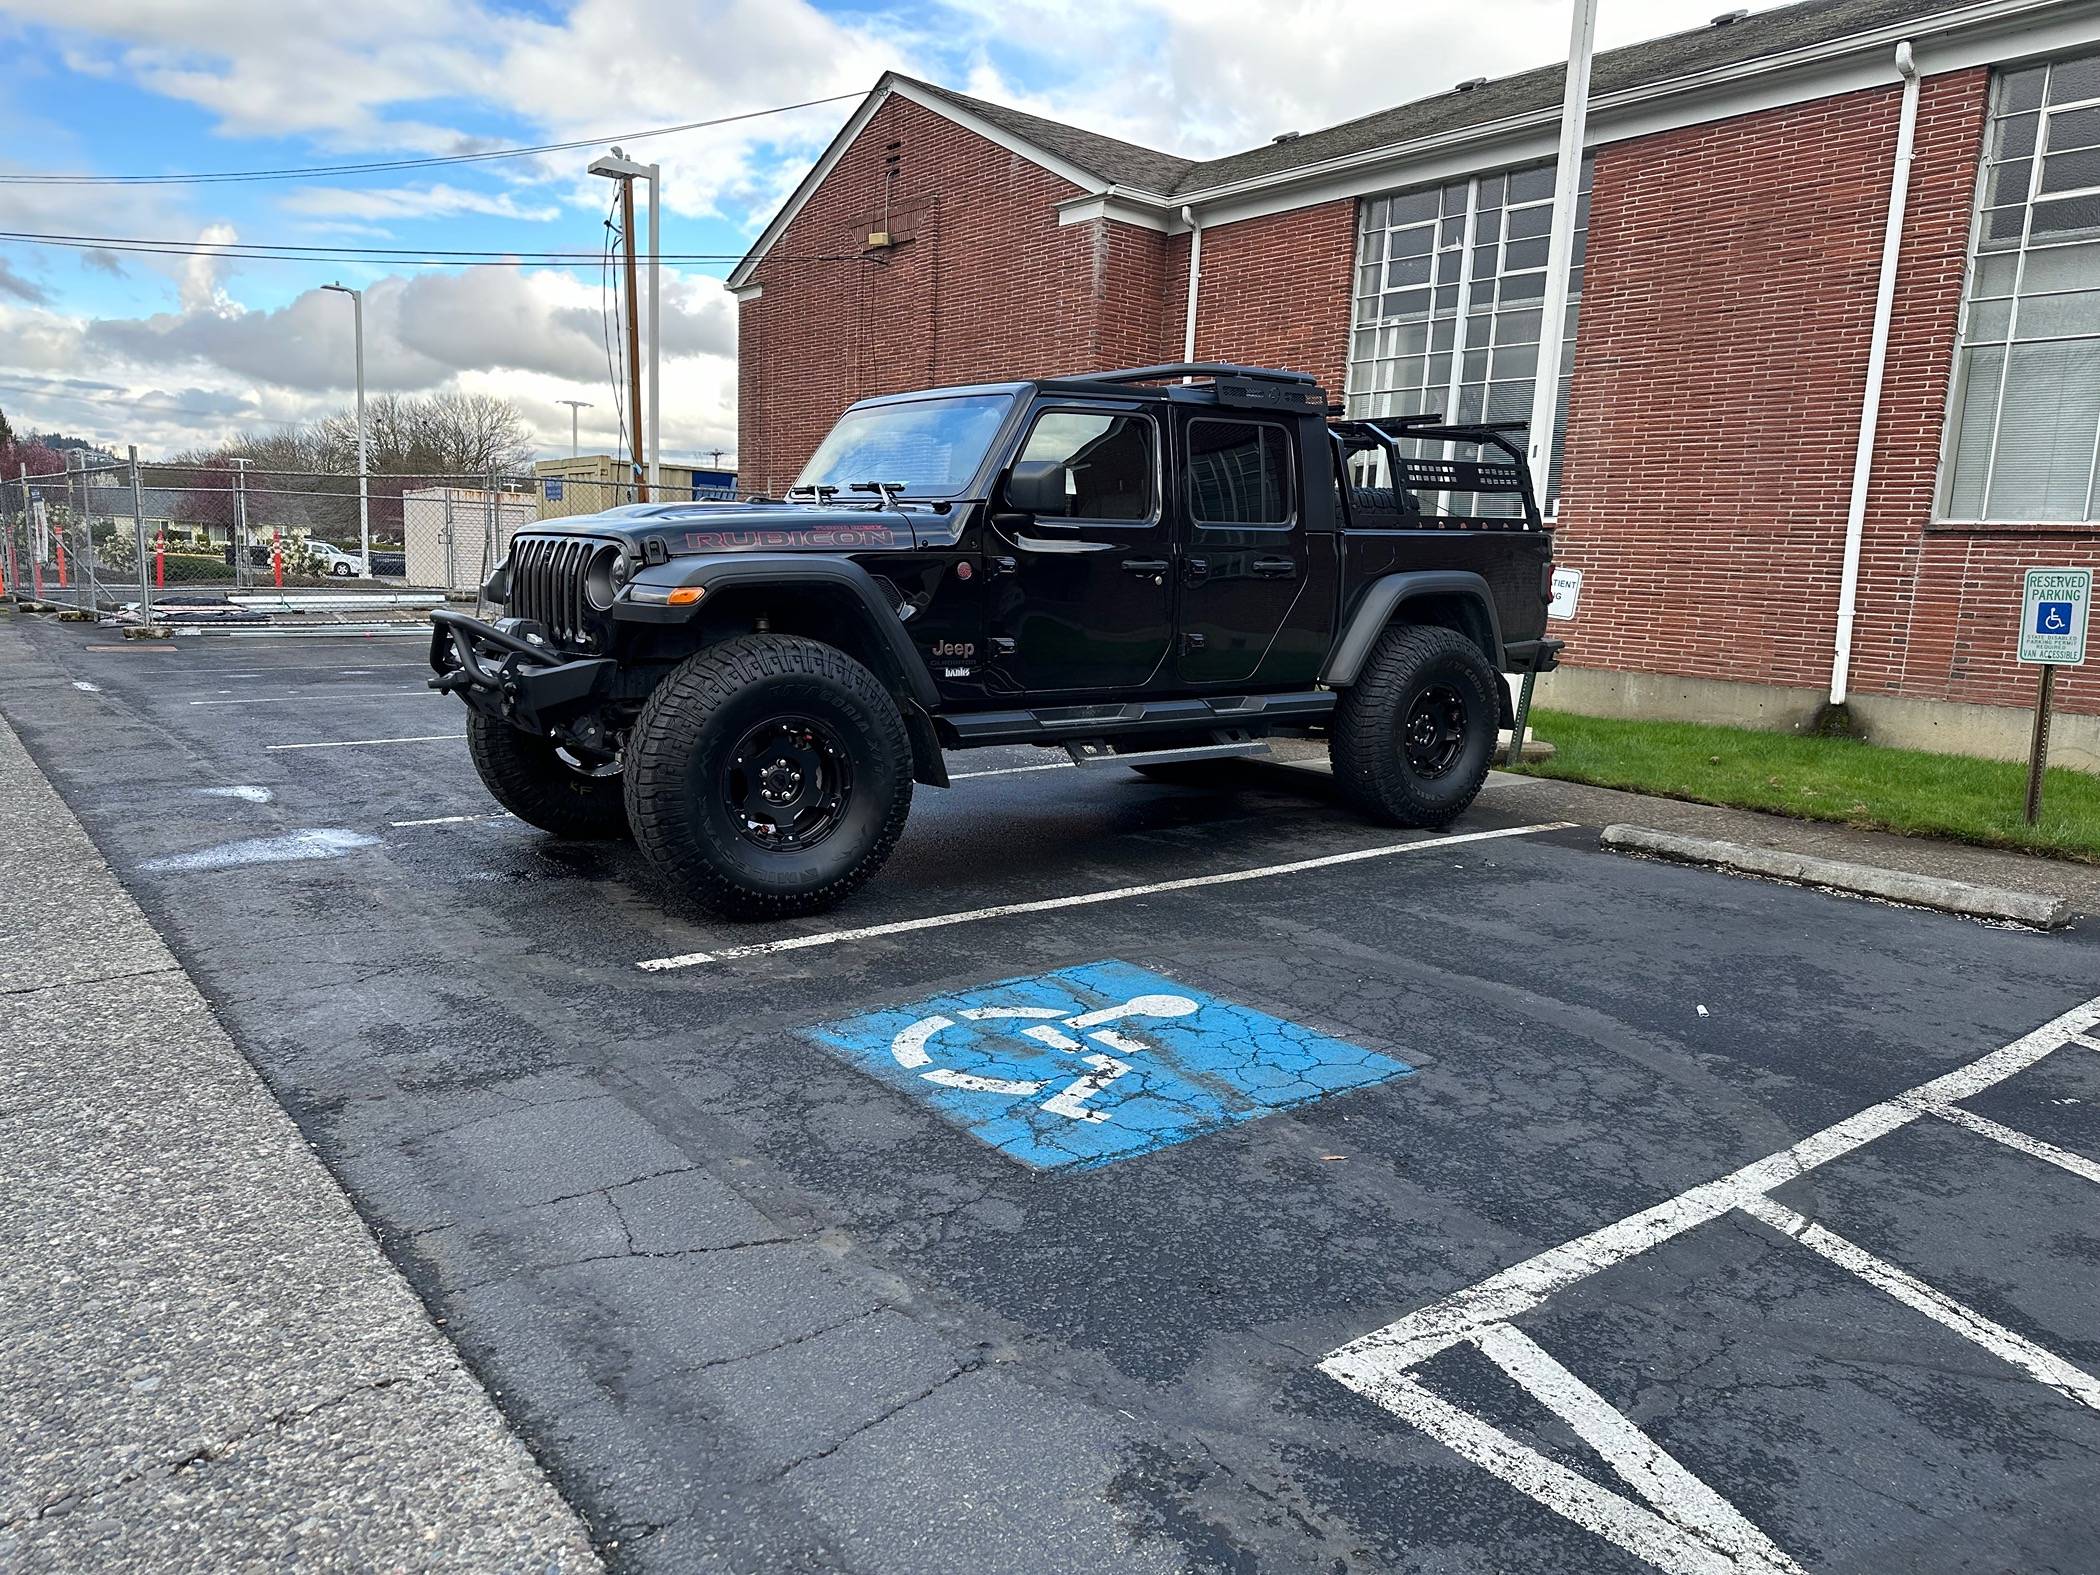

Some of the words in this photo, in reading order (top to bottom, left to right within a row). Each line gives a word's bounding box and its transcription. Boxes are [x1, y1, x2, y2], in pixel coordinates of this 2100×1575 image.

[685, 530, 895, 549] RUBICON
[1551, 578, 1577, 589] TIENT
[2029, 576, 2085, 588] RESERVED
[2031, 589, 2081, 601] PARKING
[932, 639, 975, 659] Jeep
[2023, 649, 2037, 658] VAN
[2039, 650, 2078, 660] ACCESSIBLE
